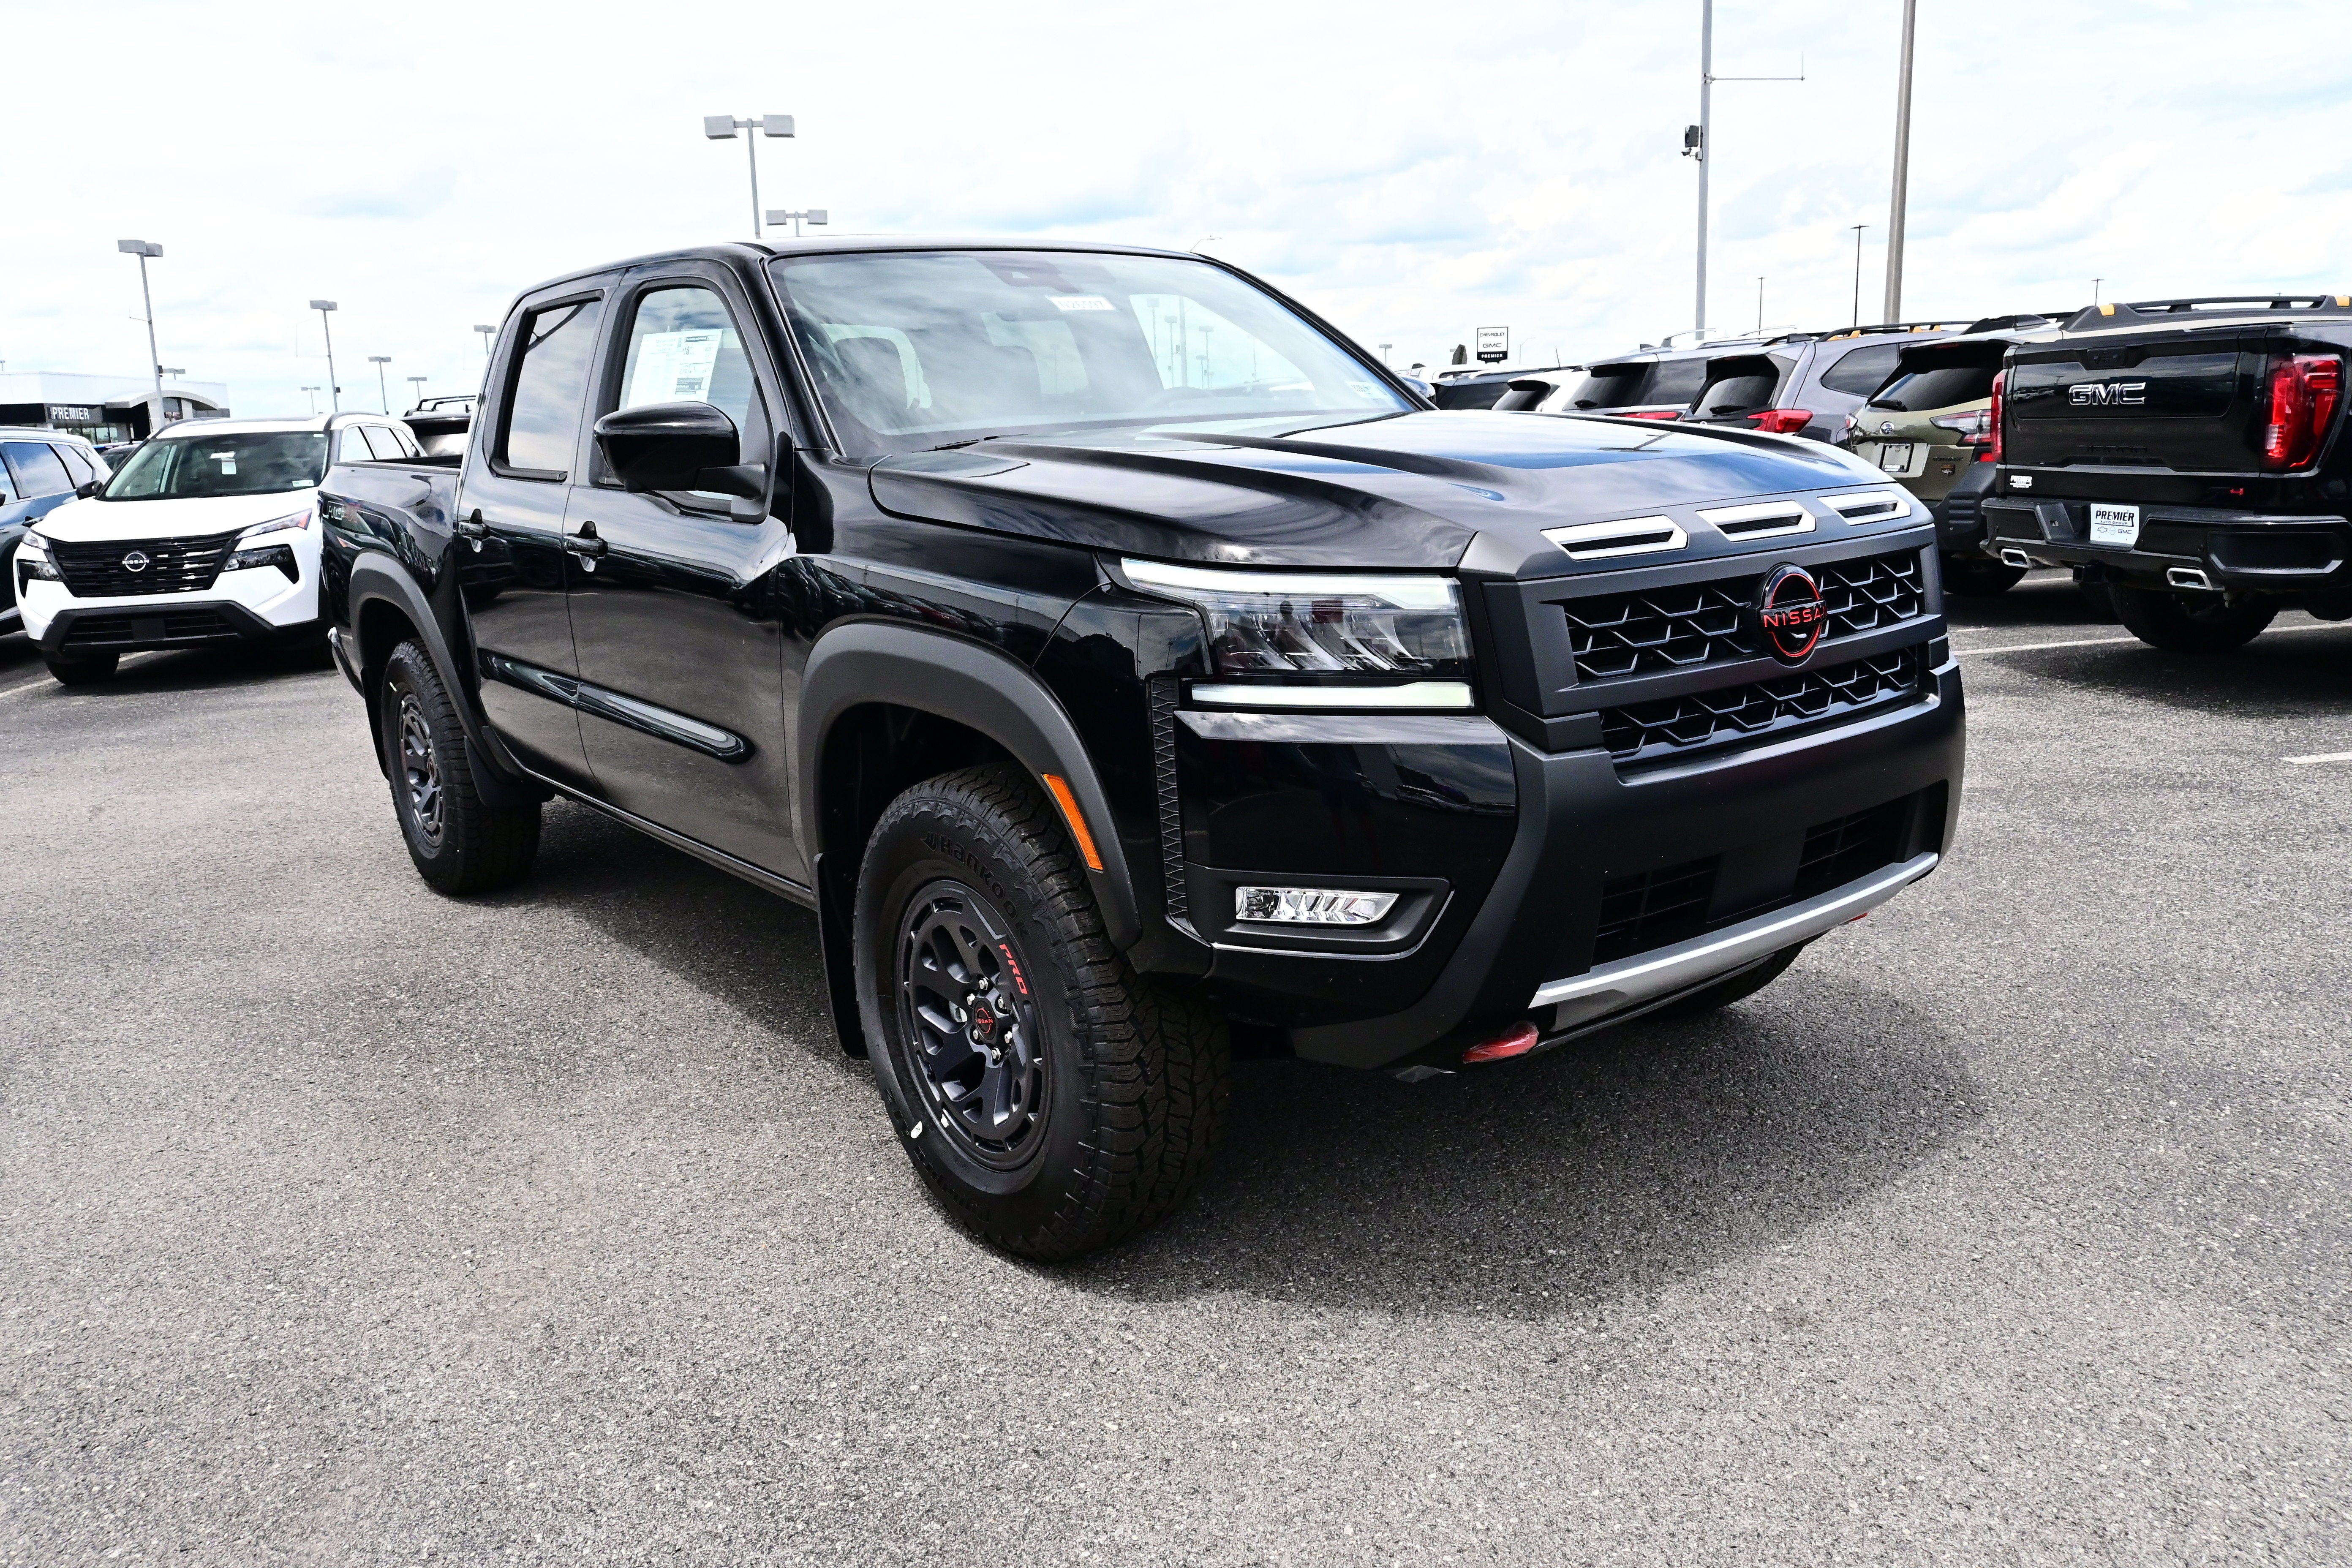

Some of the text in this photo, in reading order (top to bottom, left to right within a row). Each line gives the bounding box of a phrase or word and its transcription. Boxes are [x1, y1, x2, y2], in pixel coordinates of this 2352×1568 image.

[2069, 382, 2146, 406] GMC
[52, 407, 89, 420] PREMIER
[2096, 510, 2134, 524] PREMIER
[999, 944, 1028, 994] PRO
